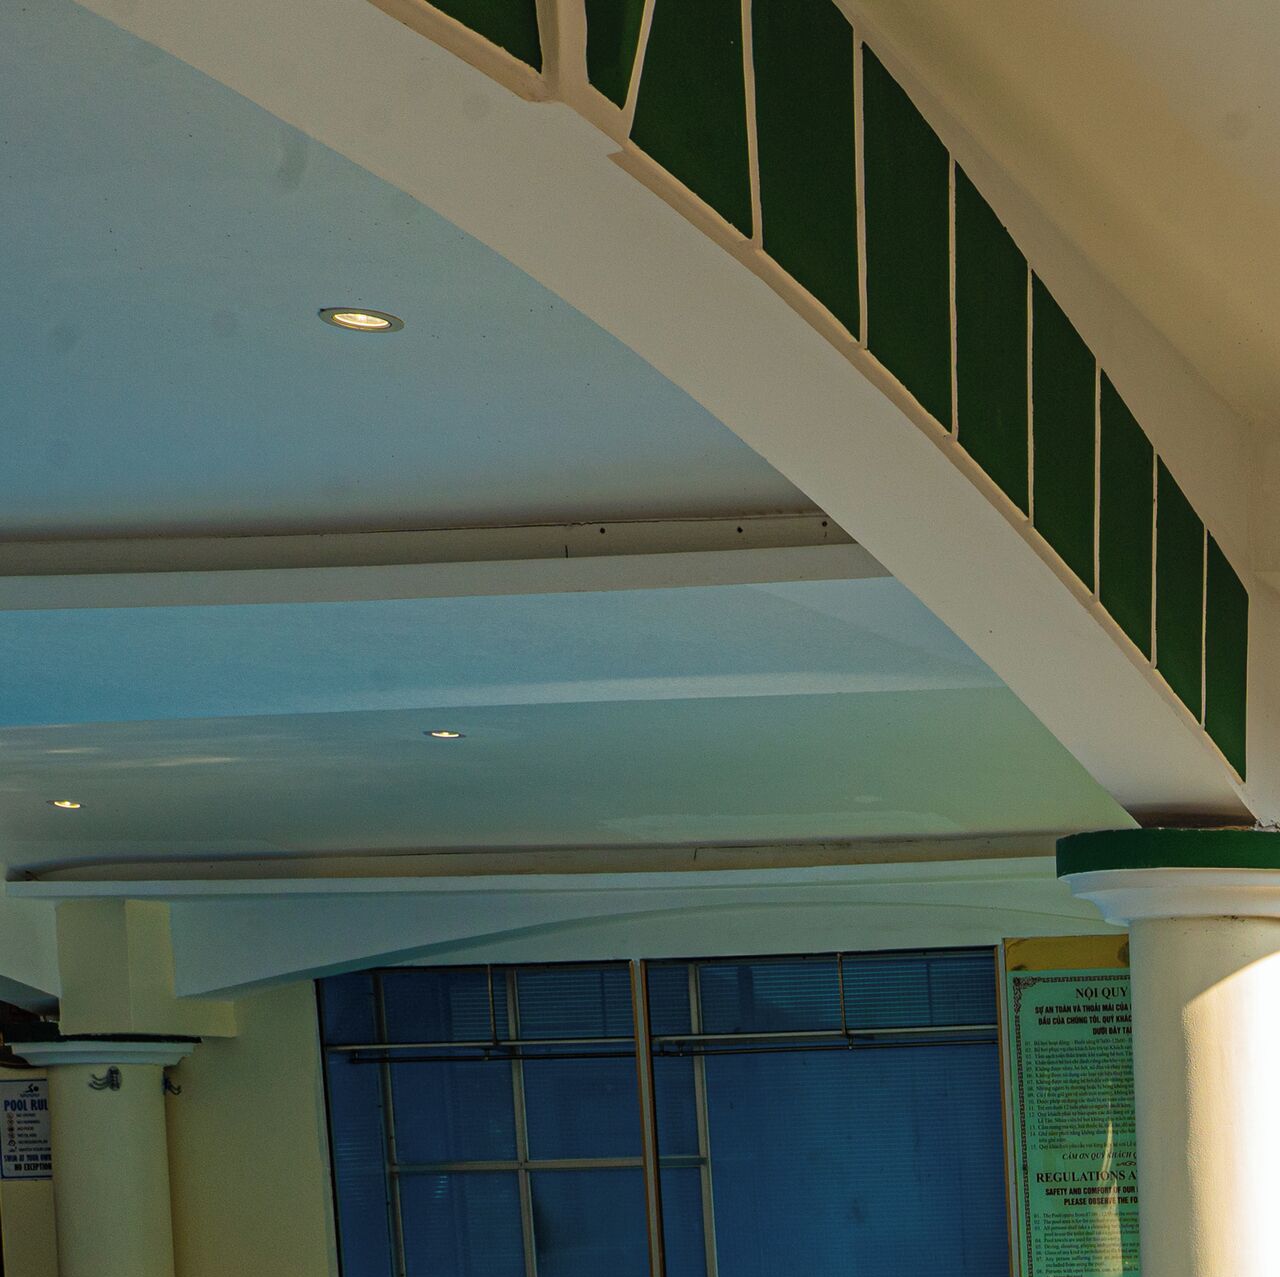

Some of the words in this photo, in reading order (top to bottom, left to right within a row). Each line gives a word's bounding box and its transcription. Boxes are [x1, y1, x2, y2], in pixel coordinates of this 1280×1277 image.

[1076, 988, 1098, 1000] NỘI
[1102, 986, 1128, 999] QUY
[1116, 1014, 1132, 1022] KHÁC
[4, 1099, 27, 1111] POOL
[30, 1099, 48, 1110] RUL
[24, 1163, 52, 1171] EXCEPTION
[1036, 1170, 1126, 1183] REGULATIONS
[1046, 1188, 1067, 1196] SAFETY
[1070, 1187, 1082, 1195] AND
[1122, 1186, 1136, 1194] OUR
[1064, 1198, 1087, 1206] PLEASE
